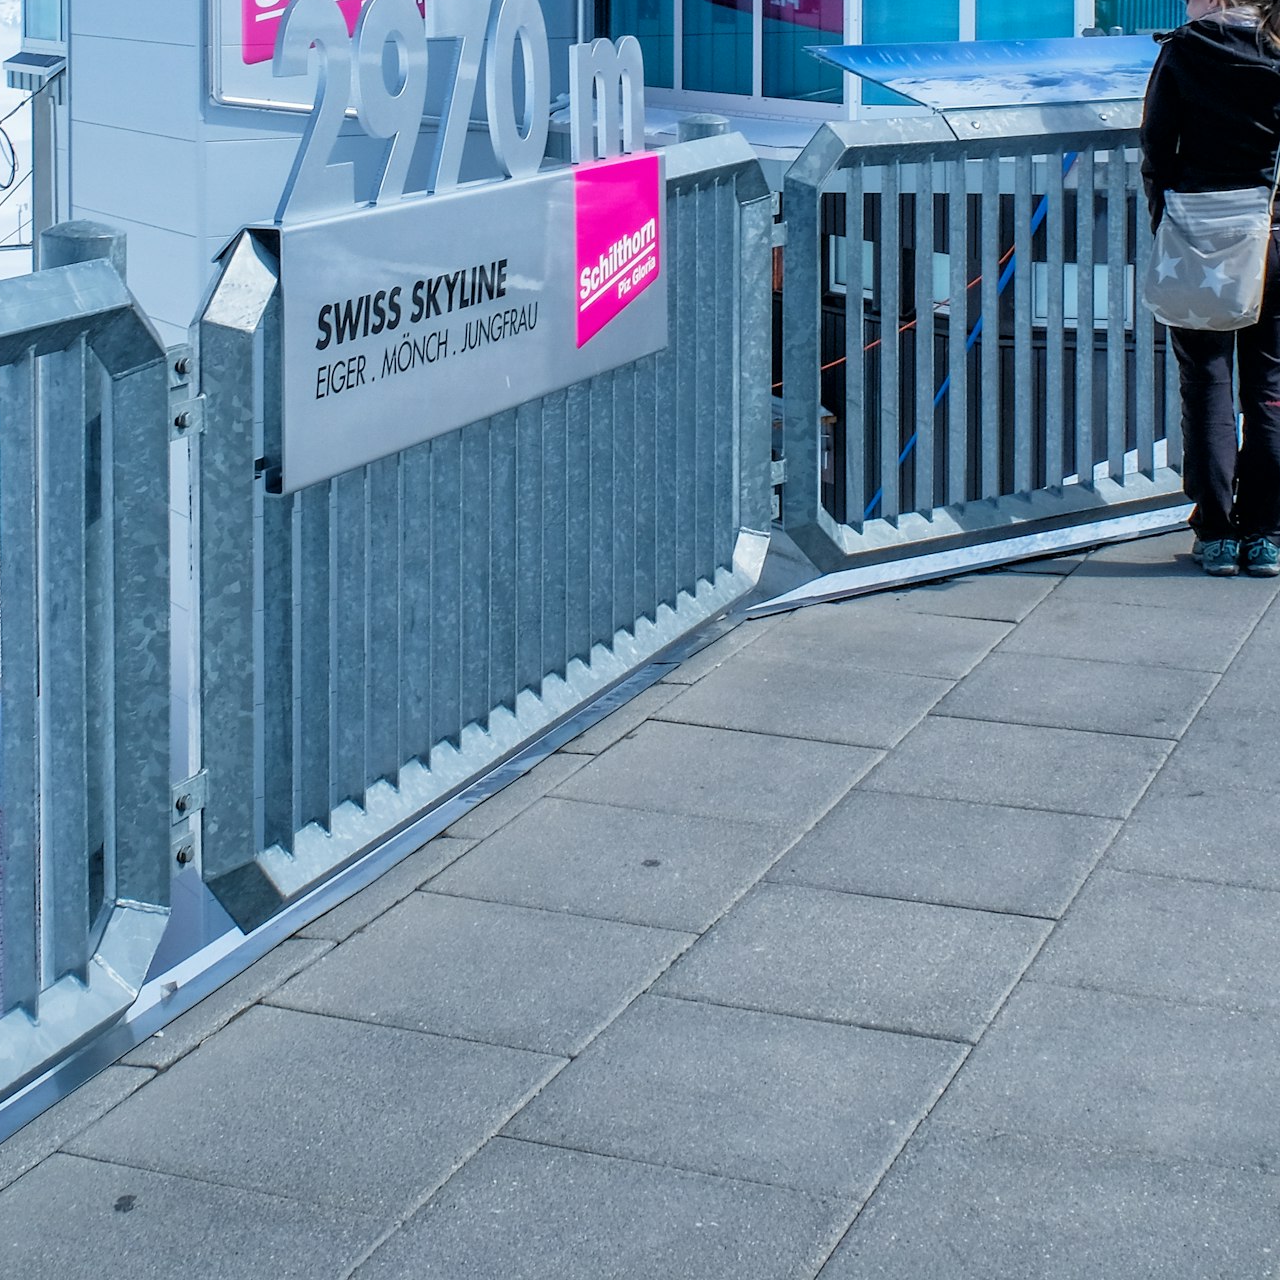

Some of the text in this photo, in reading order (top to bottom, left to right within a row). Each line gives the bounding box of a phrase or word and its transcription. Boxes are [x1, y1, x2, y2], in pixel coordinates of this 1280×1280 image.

[569, 35, 645, 165] m
[315, 258, 508, 350] SWISS SKYLINE
[580, 218, 655, 299] Schilthorn
[618, 256, 656, 299] Piz Gloria
[315, 354, 367, 400] EIGER
[381, 328, 449, 379] MÖNCH
[460, 301, 538, 353] JUNGFRAU
